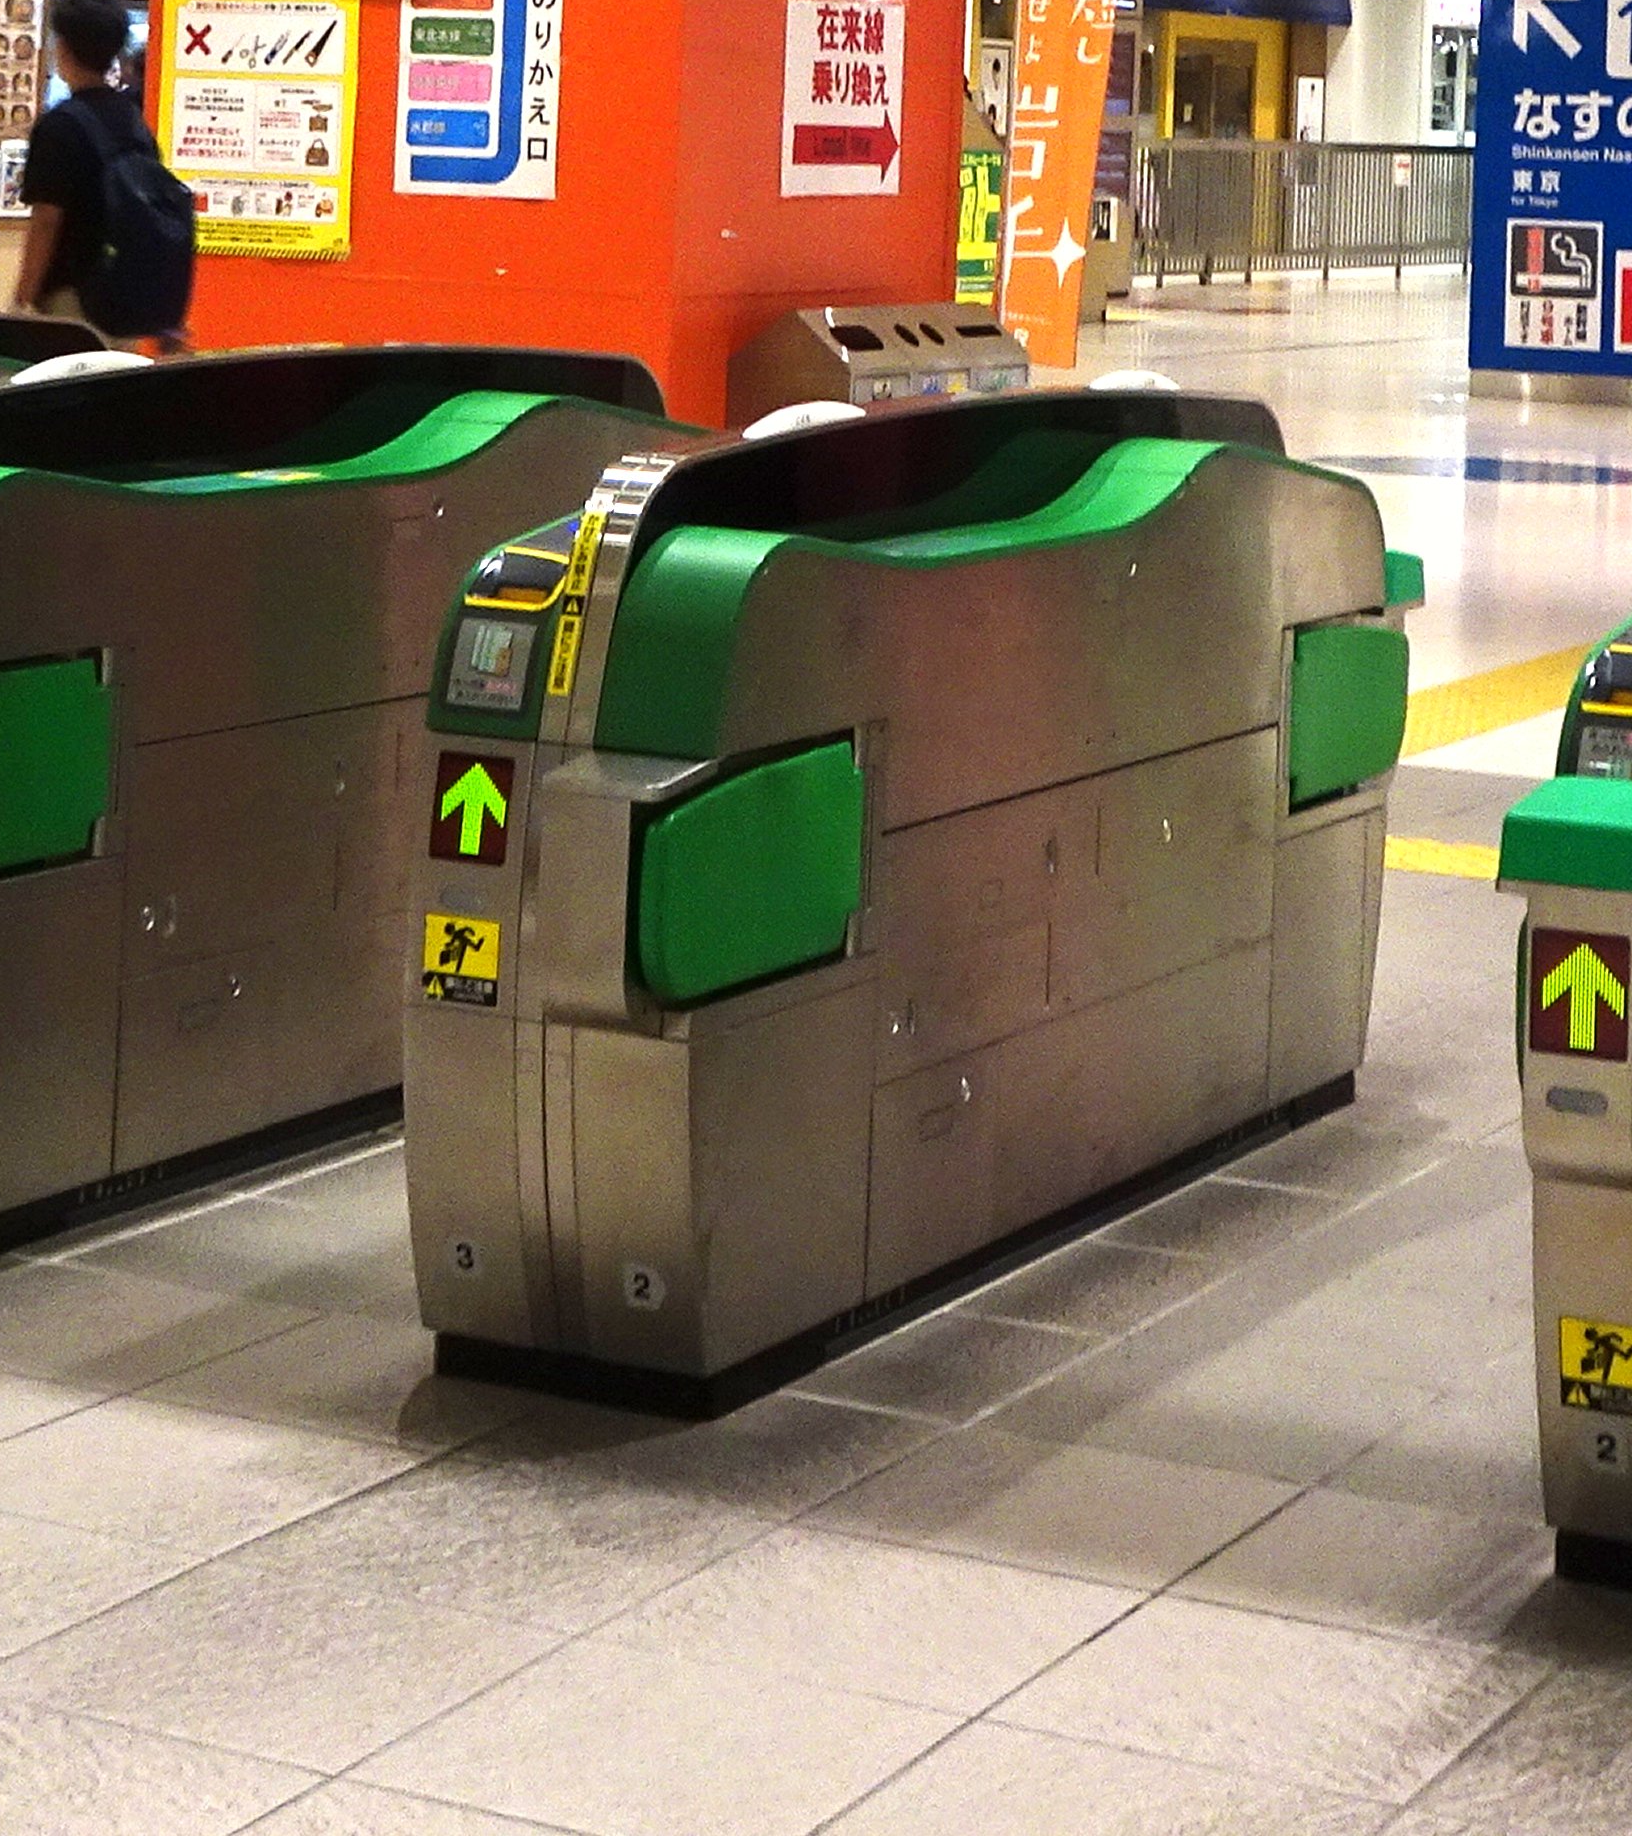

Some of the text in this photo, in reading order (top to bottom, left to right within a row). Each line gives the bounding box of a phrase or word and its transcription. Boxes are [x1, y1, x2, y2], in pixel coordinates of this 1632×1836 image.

[816, 3, 886, 54] 在来線
[810, 58, 890, 107] 乗り換え
[1511, 144, 1600, 163] Shinkansen
[1512, 168, 1562, 194] 東京
[455, 1241, 475, 1270] 3
[632, 1272, 651, 1301] 2
[1596, 1434, 1617, 1463] 2
